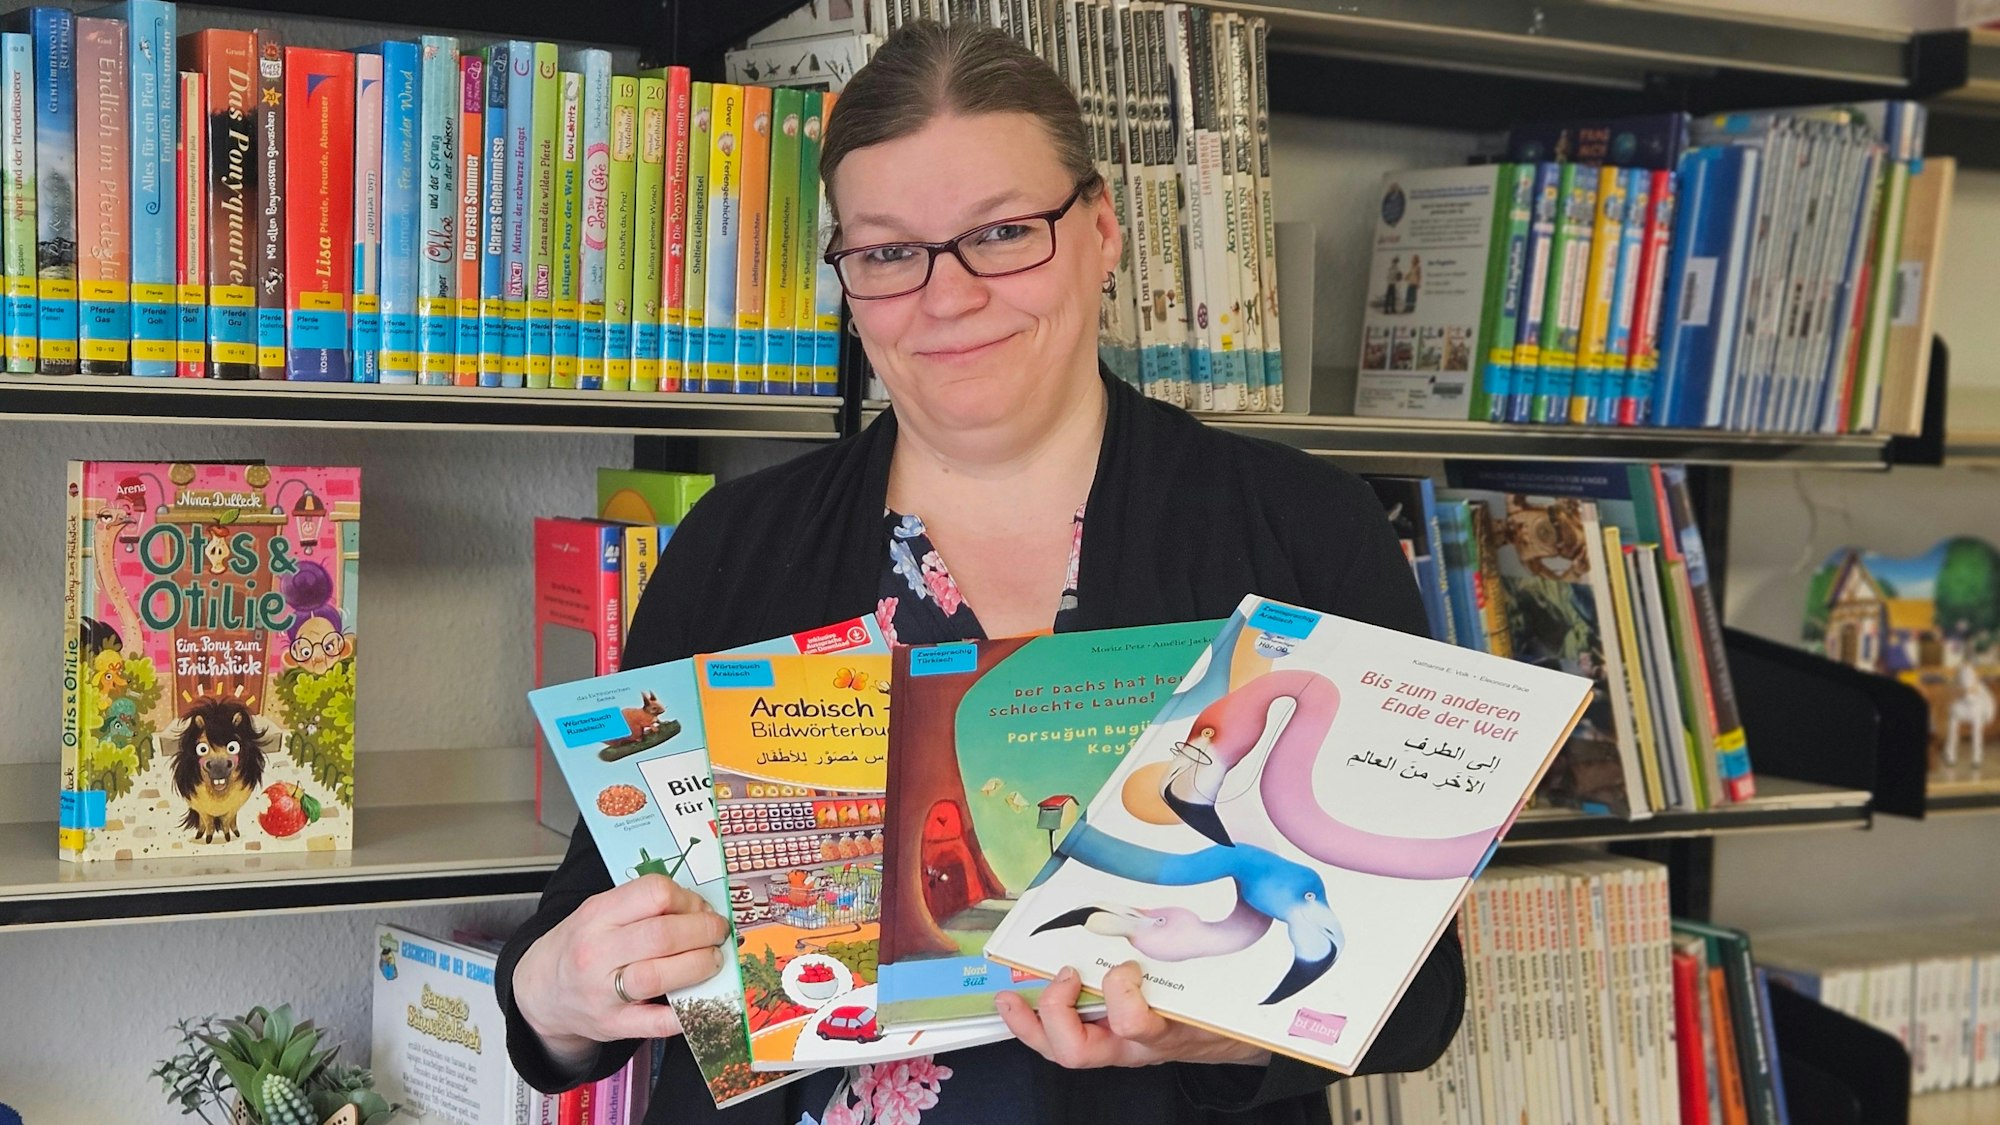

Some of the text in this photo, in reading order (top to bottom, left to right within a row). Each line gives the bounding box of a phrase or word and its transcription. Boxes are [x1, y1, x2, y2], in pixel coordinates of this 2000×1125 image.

[99, 57, 120, 136] Endlich
[161, 30, 172, 163] Endlich Reitstunden
[400, 69, 413, 110] Wind
[619, 84, 634, 98] 19
[647, 86, 665, 100] 20
[678, 94, 686, 109] ein
[726, 97, 734, 127] Clover
[142, 72, 155, 193] Alles für ein Pferd
[399, 115, 412, 138] der
[12, 151, 23, 167] der
[99, 144, 118, 171] im
[427, 134, 442, 209] und der Sprung
[443, 163, 453, 180] der
[13, 169, 23, 190] und
[221, 67, 251, 289] Das Ponyquarte
[265, 111, 282, 259] Mit allen Ponywassern gewaschen
[316, 96, 332, 277] Lisa Pferde, Freunde, Abenteuer
[444, 182, 453, 191] in
[511, 127, 526, 254] Mistral, der schwarze Hengst
[670, 141, 685, 223] Pony-Truppe
[462, 153, 480, 261] Der erste Sommer
[488, 137, 505, 256] Claras Geheimnisse
[538, 139, 551, 256] Lena und die wilden Pferde
[619, 191, 628, 212] Prinz!
[649, 184, 658, 215] Wunsch
[720, 160, 732, 236] Feriengeschichten
[692, 175, 705, 274] Shelties Lieblingsrätsel
[1159, 180, 1173, 264] ENTDECKER
[1190, 177, 1203, 250] ZUKUNFT
[1224, 190, 1237, 254] ÄGYPTEN
[1238, 186, 1252, 269] AMPHIBIEN
[1262, 190, 1274, 259] REPTILIEN
[422, 215, 454, 264] Chloé
[562, 169, 574, 296] klügste Pony der Welt
[618, 230, 628, 258] schaffst
[648, 216, 658, 250] geheimer
[672, 224, 681, 240] Die
[1133, 175, 1151, 302] DIE KUNST DES BAUENS
[619, 259, 627, 270] Du
[509, 261, 524, 297] RANCH
[535, 263, 550, 299] RANCH
[90, 306, 116, 315] Pferde
[116, 482, 147, 495] Arena
[176, 491, 263, 509] Nina Dulleck
[65, 515, 78, 560] Frühstück
[636, 537, 647, 557] auf
[67, 560, 77, 577] zum
[268, 535, 300, 578] &
[64, 578, 81, 603] Pony
[138, 579, 297, 632] Otilie
[606, 597, 618, 661] für alle Fälle
[175, 636, 262, 658] Ein Pony zum
[1091, 645, 1122, 654] Moritz
[1125, 643, 1145, 652] Petz
[63, 637, 79, 690] Otilie
[177, 656, 263, 677] Frühstück
[712, 670, 751, 678] Arabisch
[1015, 686, 1044, 698] Der
[1053, 680, 1106, 695] Dachs
[1114, 675, 1147, 690] hat
[1092, 691, 1156, 709] Laune!
[1360, 670, 1521, 723] Bis zum anderen
[1511, 684, 1530, 693] Pace
[562, 713, 612, 729] Wörterbuch
[750, 696, 875, 718] Arabisch
[1381, 697, 1520, 743] Ende der Welt
[62, 701, 77, 747] Otis
[566, 723, 606, 736] Russisch
[751, 721, 890, 738] Bildwörterbu
[1007, 726, 1098, 744] Porsuğun
[675, 799, 704, 817] für
[439, 951, 450, 973] AUS
[452, 956, 464, 976] DER
[962, 966, 988, 977] Nord
[962, 975, 988, 987] Süd
[1142, 972, 1186, 992] Arabisch
[580, 1089, 590, 1107] für
